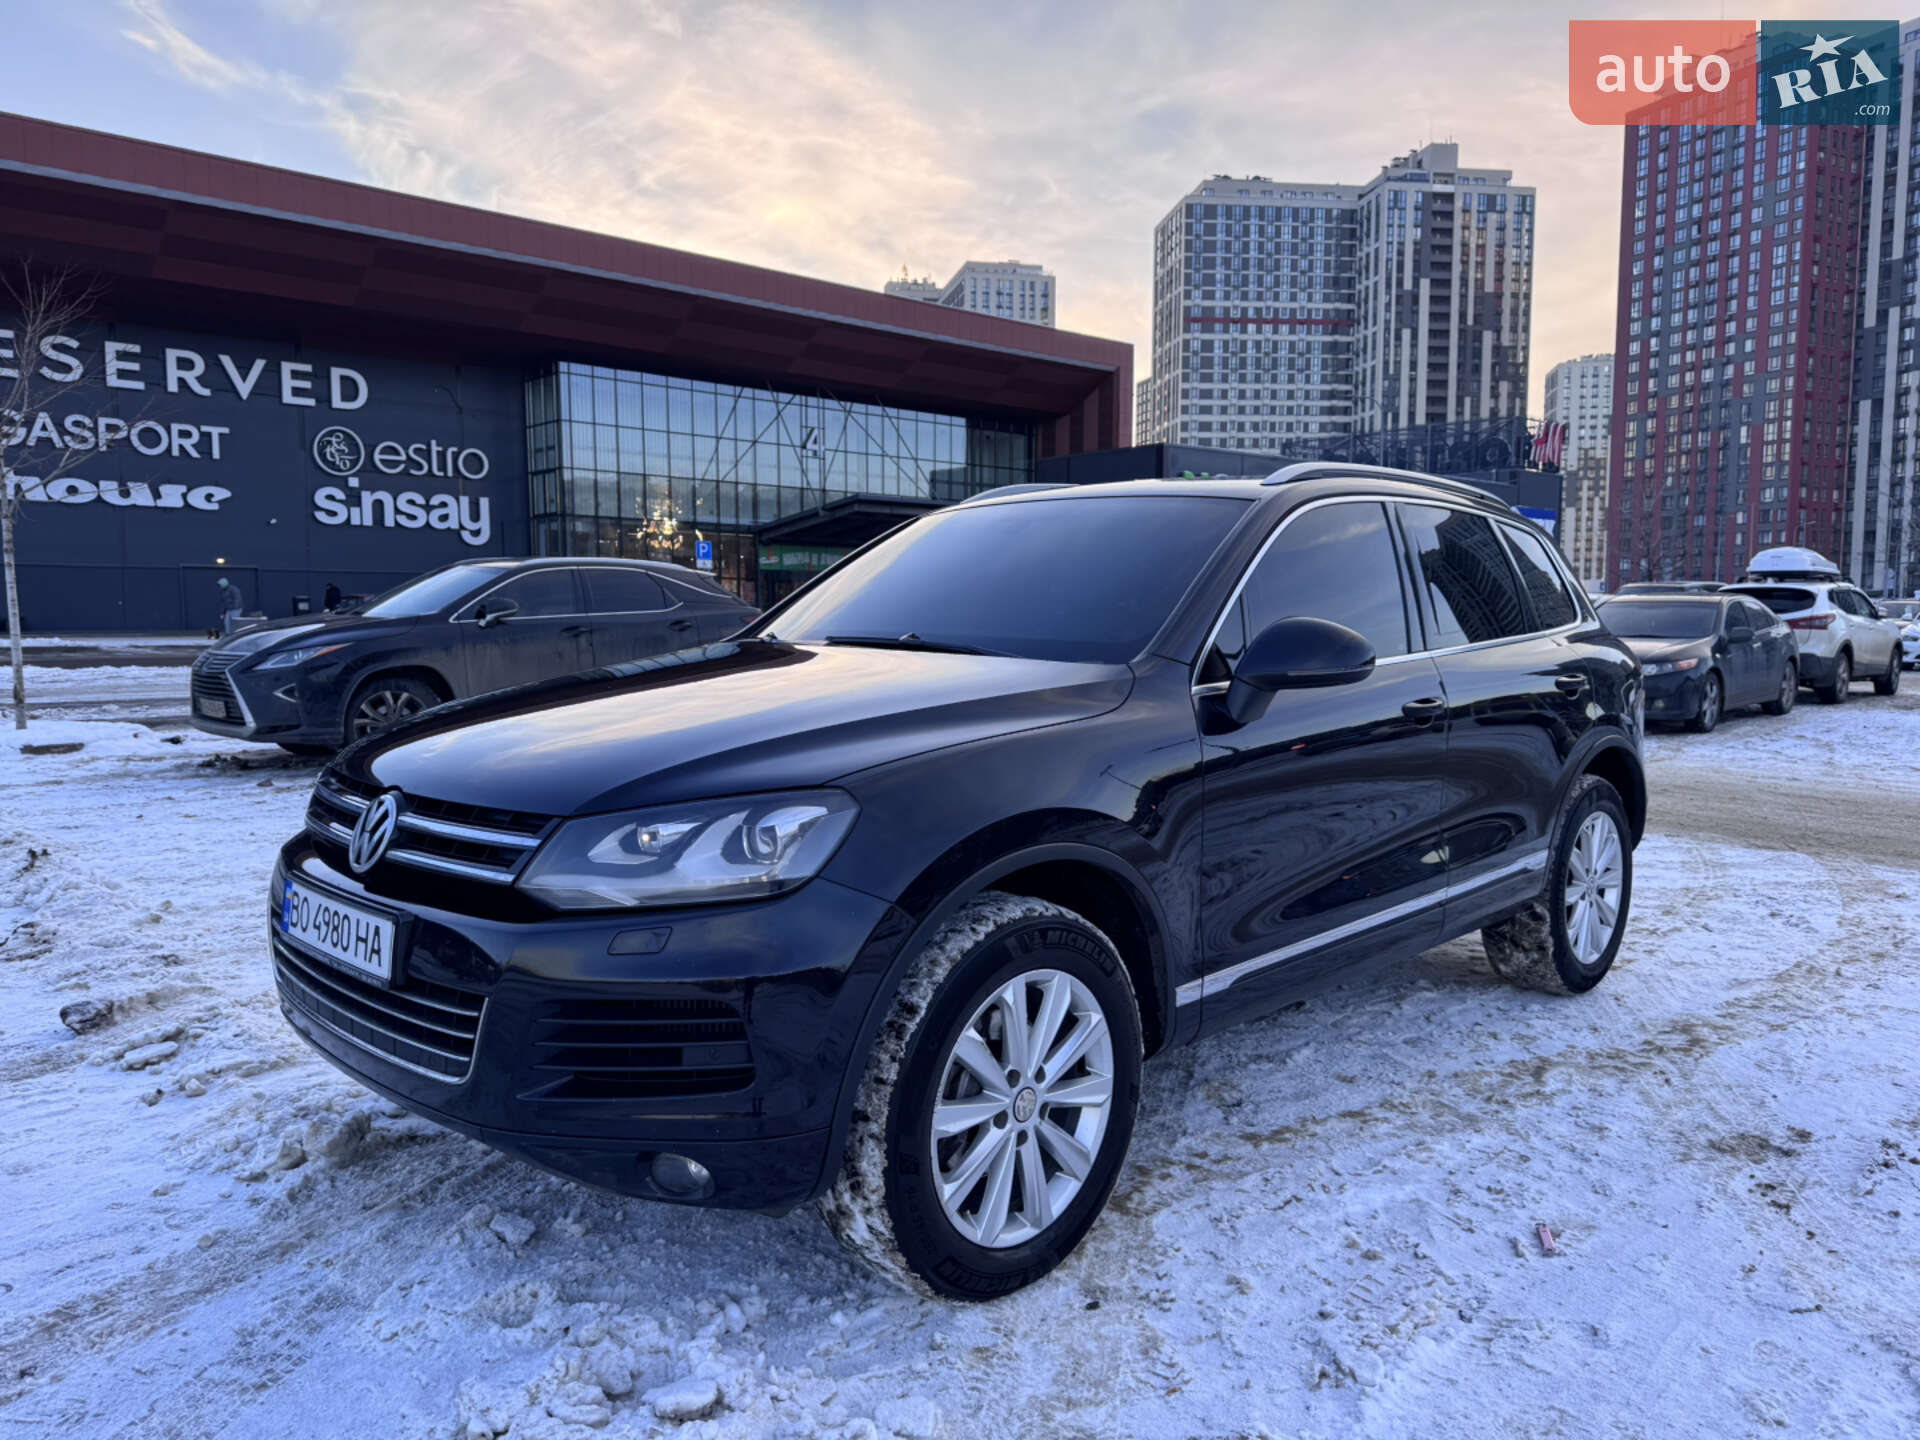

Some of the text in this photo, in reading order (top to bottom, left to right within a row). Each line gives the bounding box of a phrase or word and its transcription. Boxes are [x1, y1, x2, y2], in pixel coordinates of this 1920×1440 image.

[373, 439, 489, 479] estro
[313, 477, 491, 546] sinsay
[700, 543, 709, 557] P
[312, 903, 352, 953] 4980
[354, 917, 383, 968] HA
